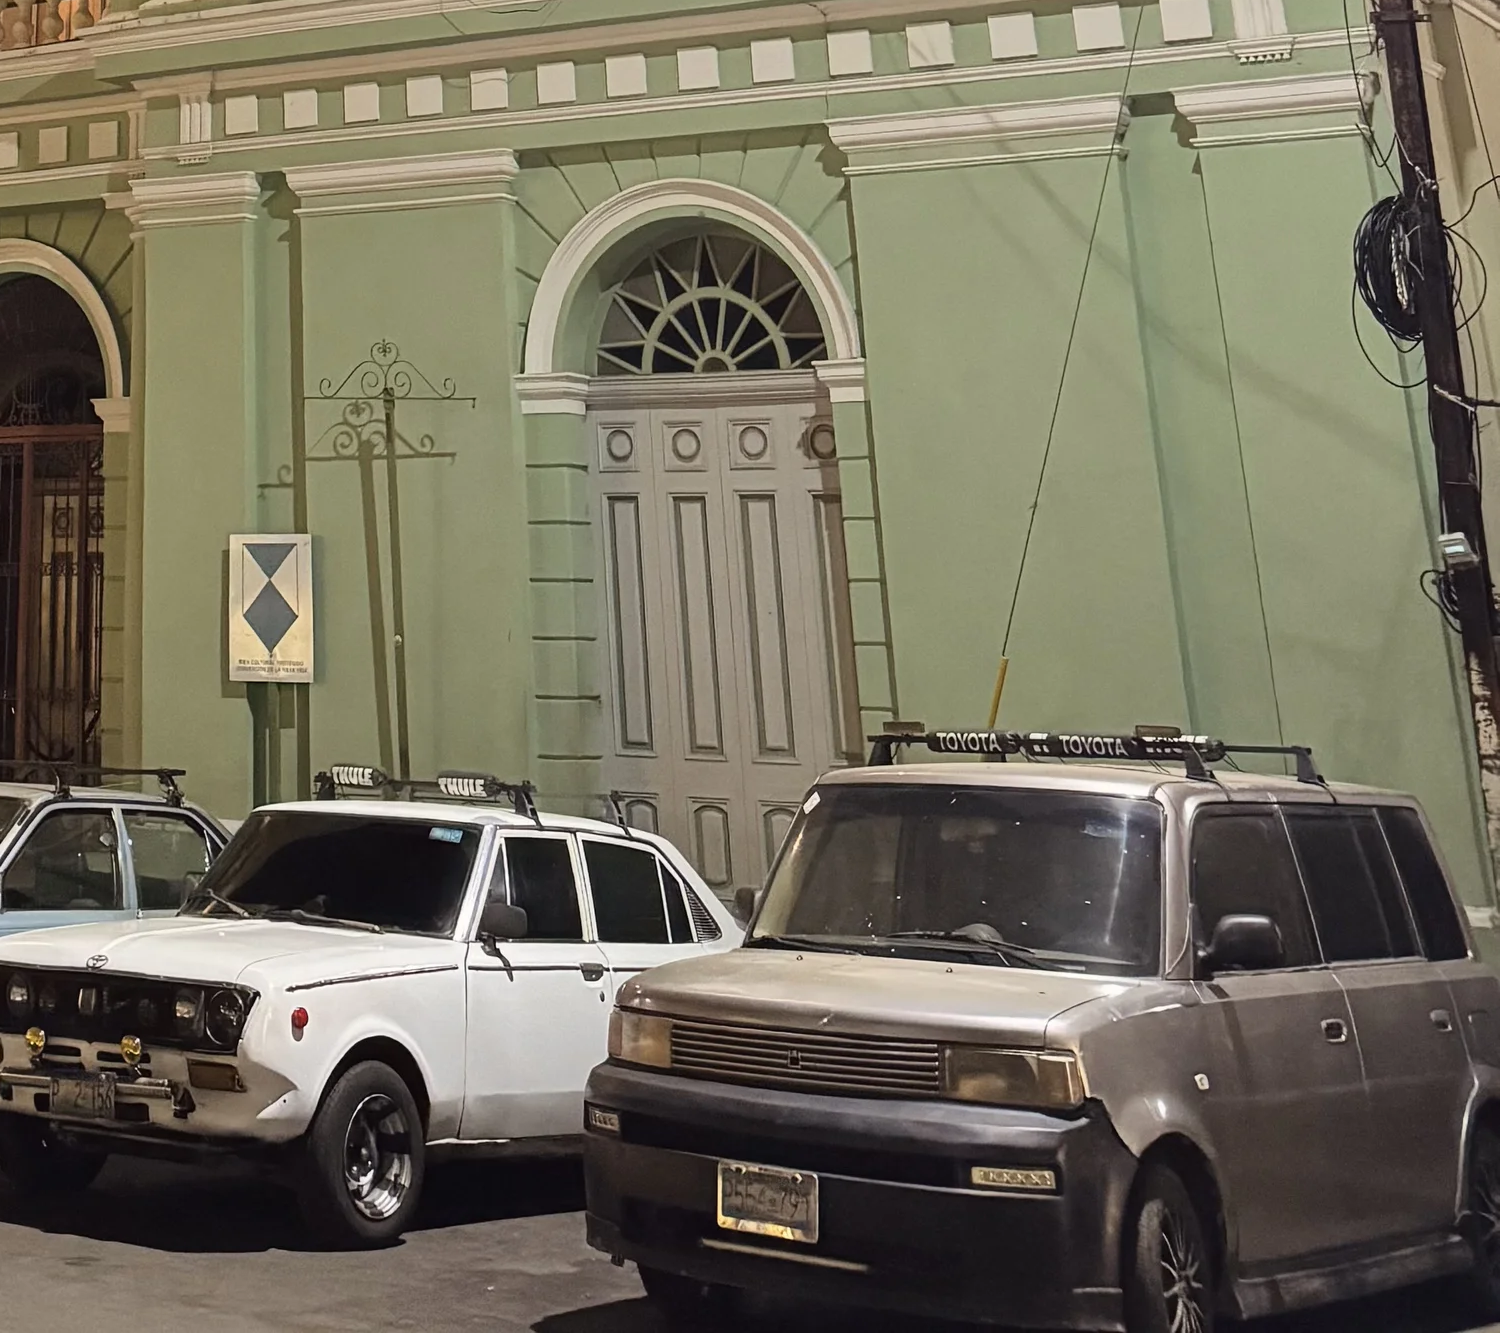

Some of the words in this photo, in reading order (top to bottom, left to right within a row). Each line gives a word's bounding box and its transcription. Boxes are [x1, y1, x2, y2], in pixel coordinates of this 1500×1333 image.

[936, 732, 1002, 752] TOYOTA
[1058, 734, 1129, 757] TOYOTA
[331, 766, 374, 786] THULE
[438, 777, 488, 798] THULE
